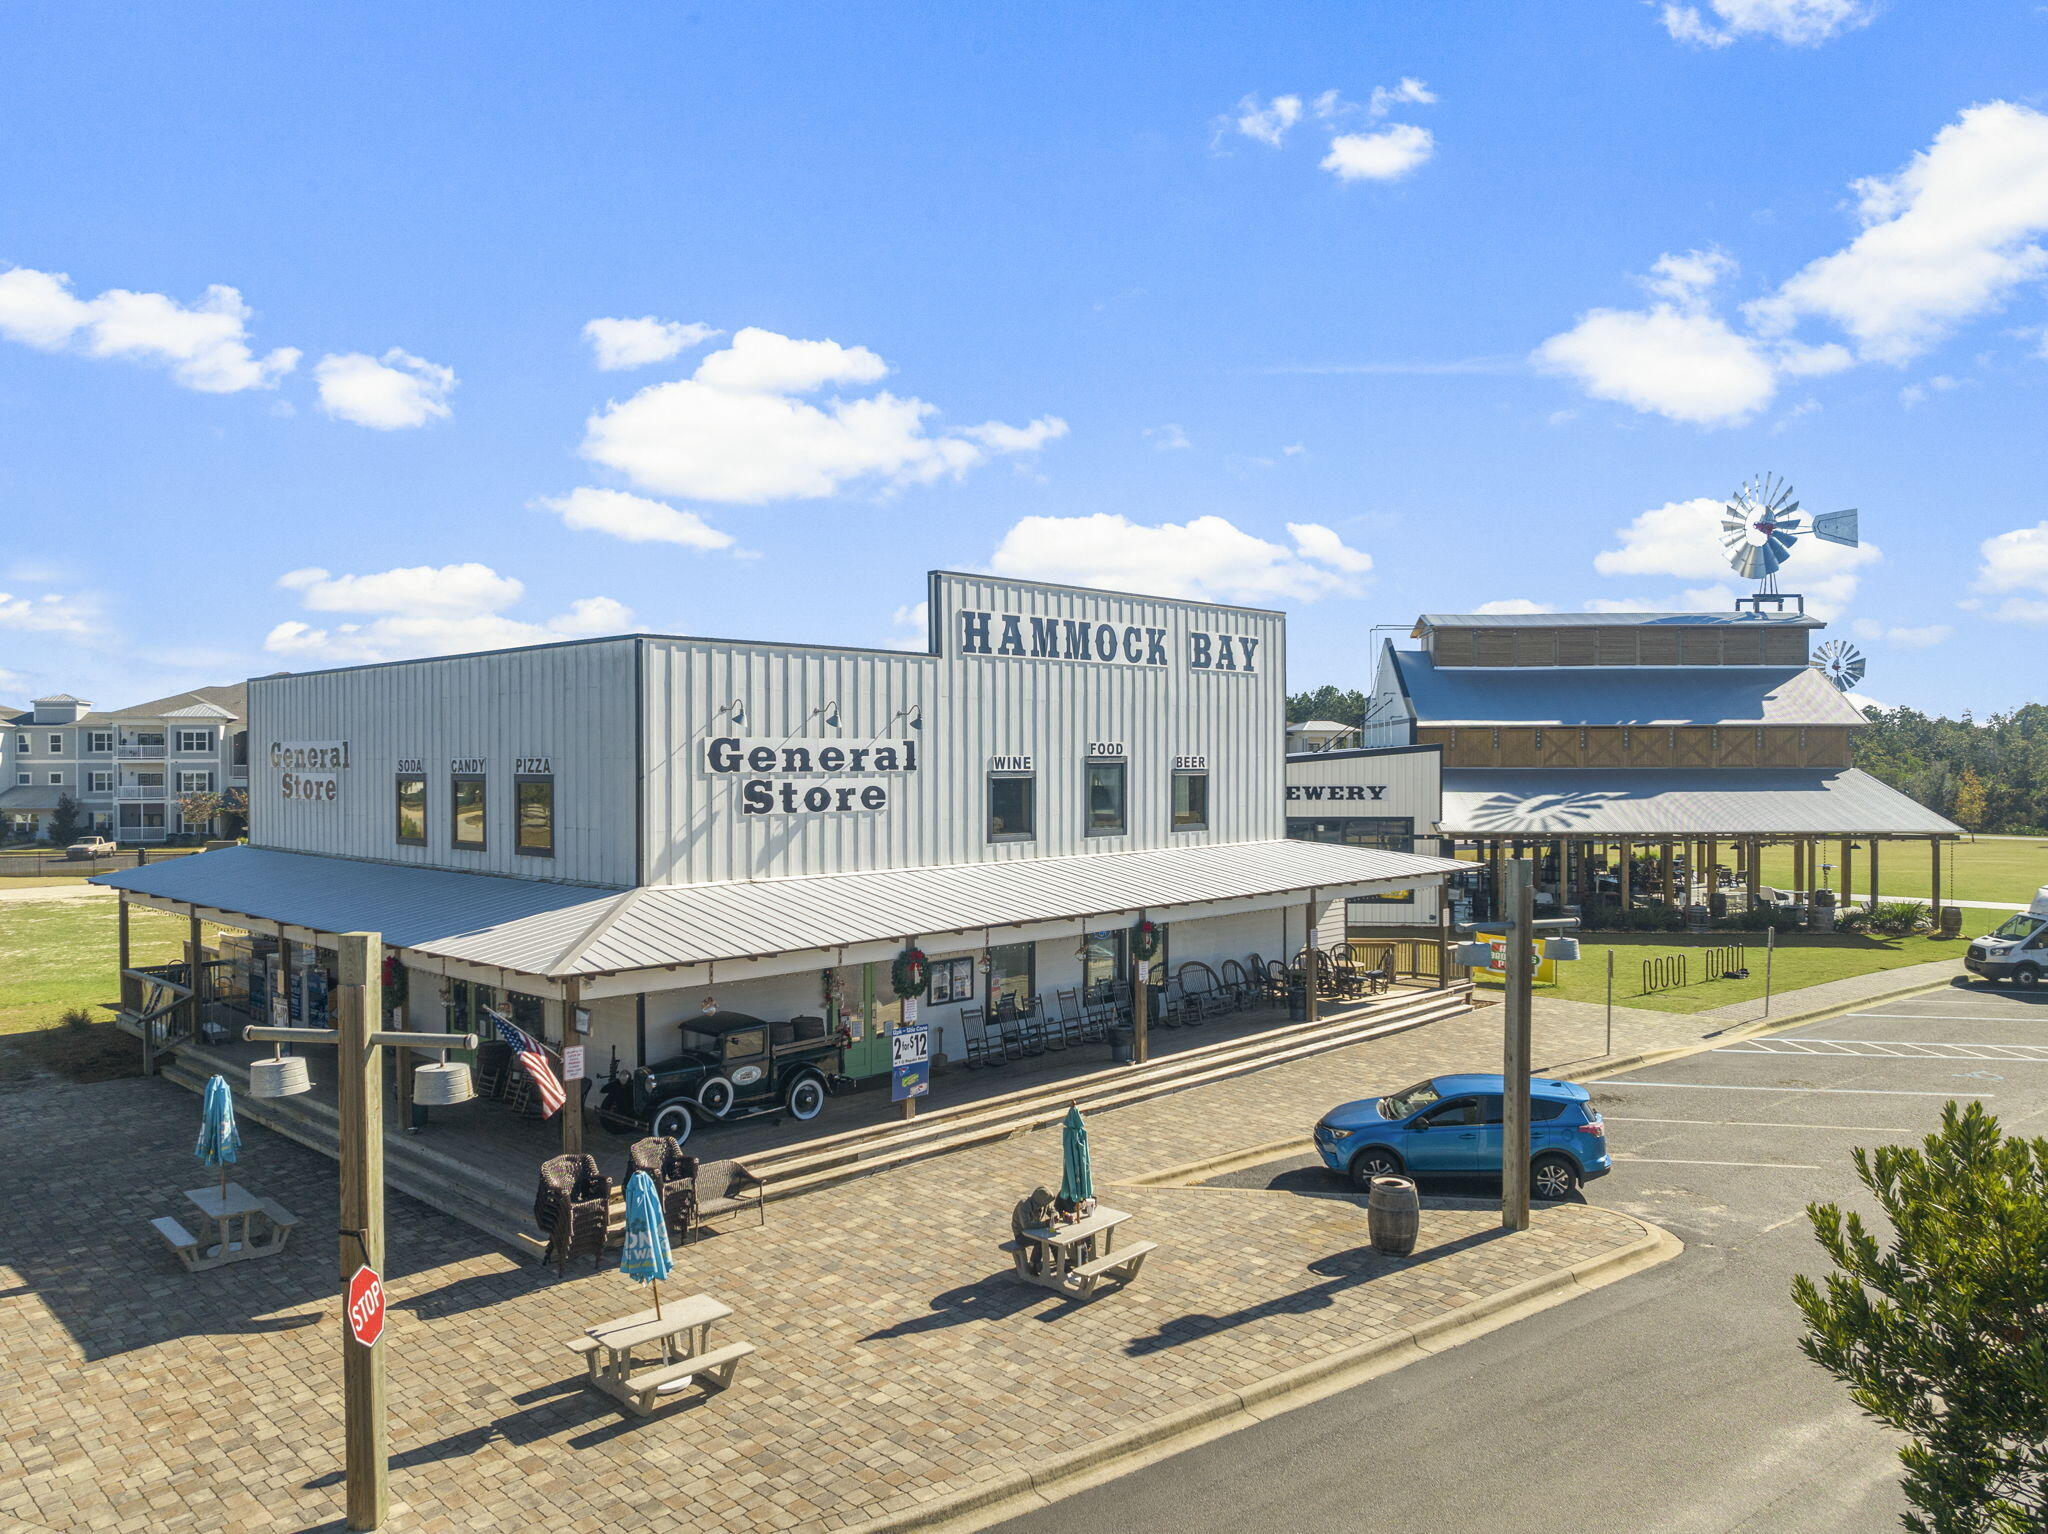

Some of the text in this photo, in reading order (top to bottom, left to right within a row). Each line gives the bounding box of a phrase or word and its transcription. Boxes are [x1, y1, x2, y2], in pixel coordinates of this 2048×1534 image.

[961, 611, 1259, 672] HAMMOCK BAY
[270, 741, 350, 769] General
[707, 737, 917, 773] General
[1090, 743, 1124, 755] FOOD
[398, 759, 423, 773] SODA
[451, 758, 486, 773] CANDY
[515, 758, 551, 773] PIZZA
[994, 756, 1032, 770] WINE
[1175, 756, 1206, 768] BEER
[282, 772, 337, 800] Store
[1285, 785, 1387, 801] EWERY
[743, 779, 886, 815] Store
[894, 1037, 901, 1060] 2
[910, 1033, 926, 1055] $12
[352, 1280, 380, 1332] STOP
